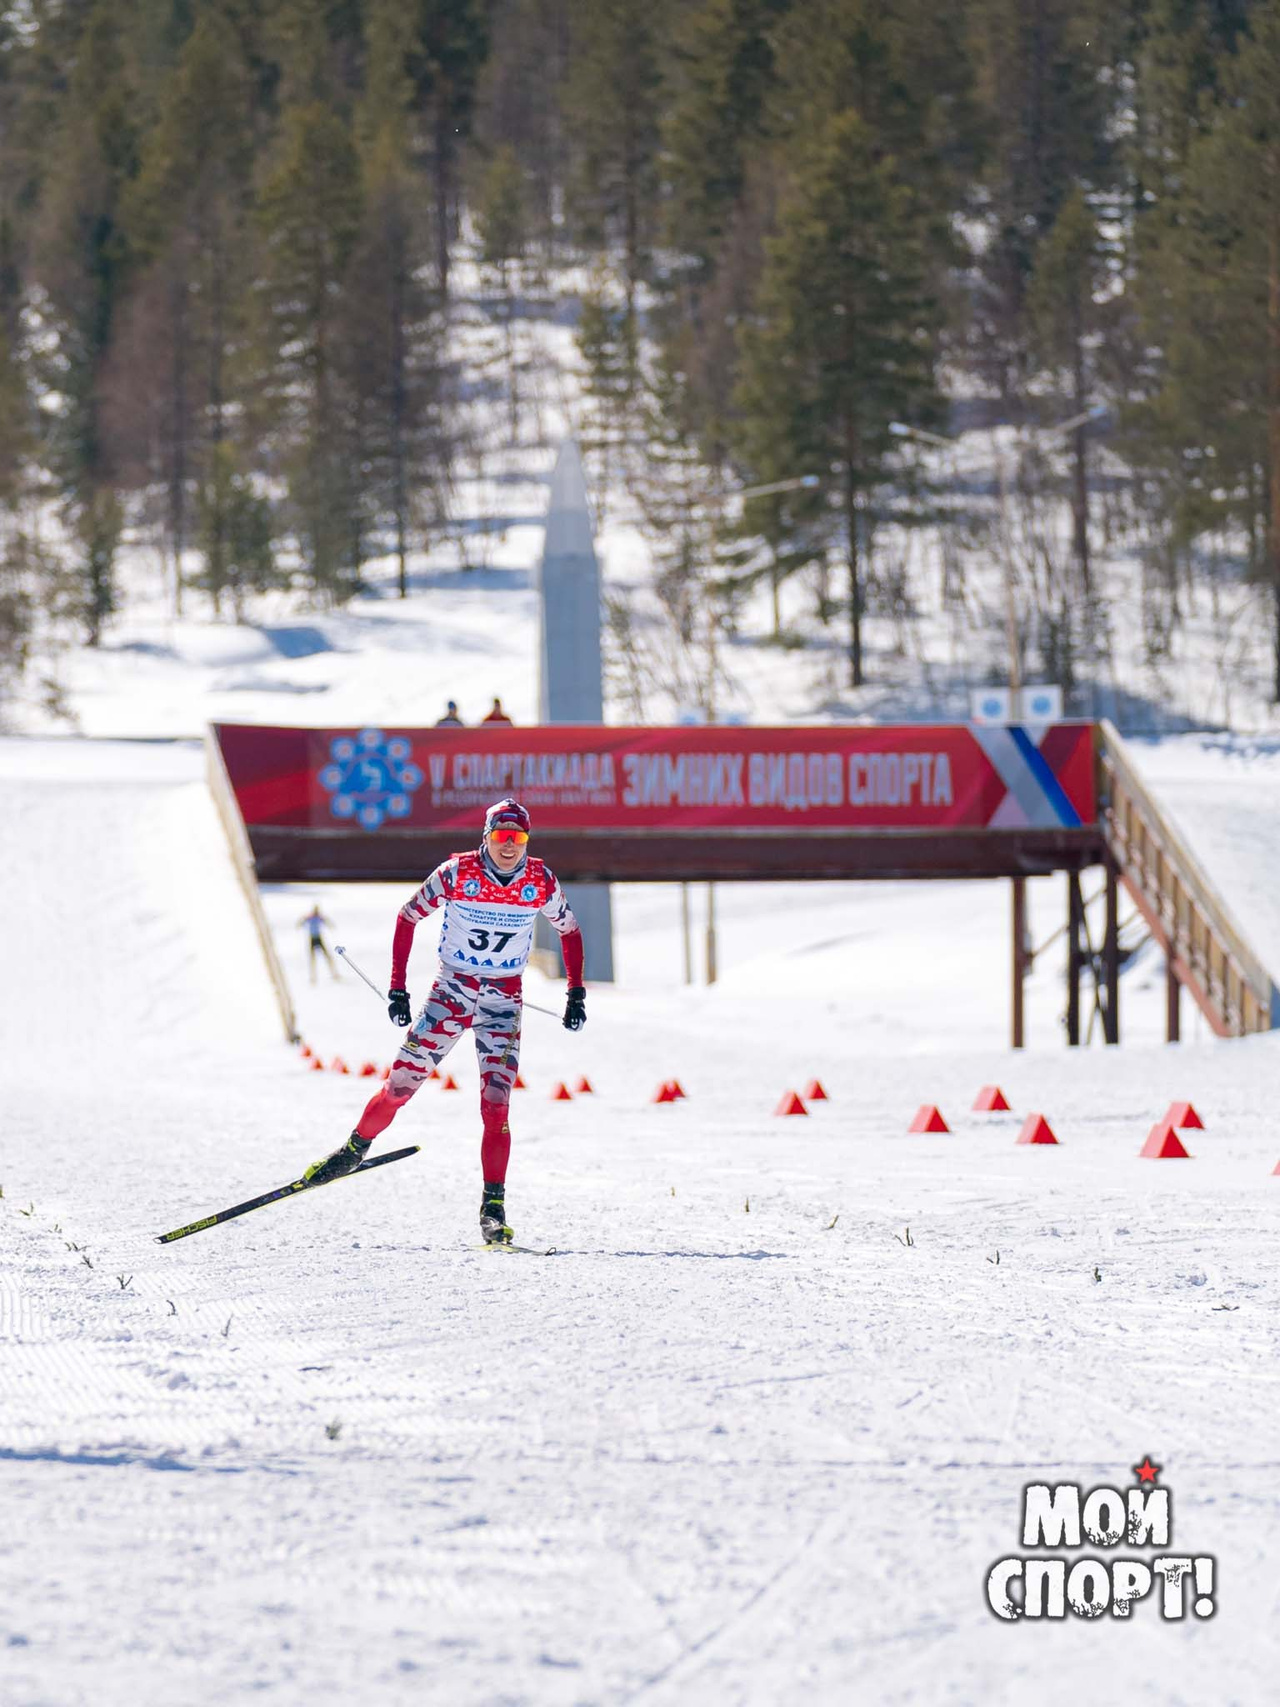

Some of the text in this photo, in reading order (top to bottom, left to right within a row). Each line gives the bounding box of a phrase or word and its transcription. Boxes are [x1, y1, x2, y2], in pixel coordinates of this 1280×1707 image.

[429, 754, 447, 788] V
[453, 752, 953, 810] СПАРТАКИАДА ЗИМНИХ ВИДОВ СПОРТА
[468, 928, 518, 952] 37
[166, 1214, 218, 1241] FISCHER
